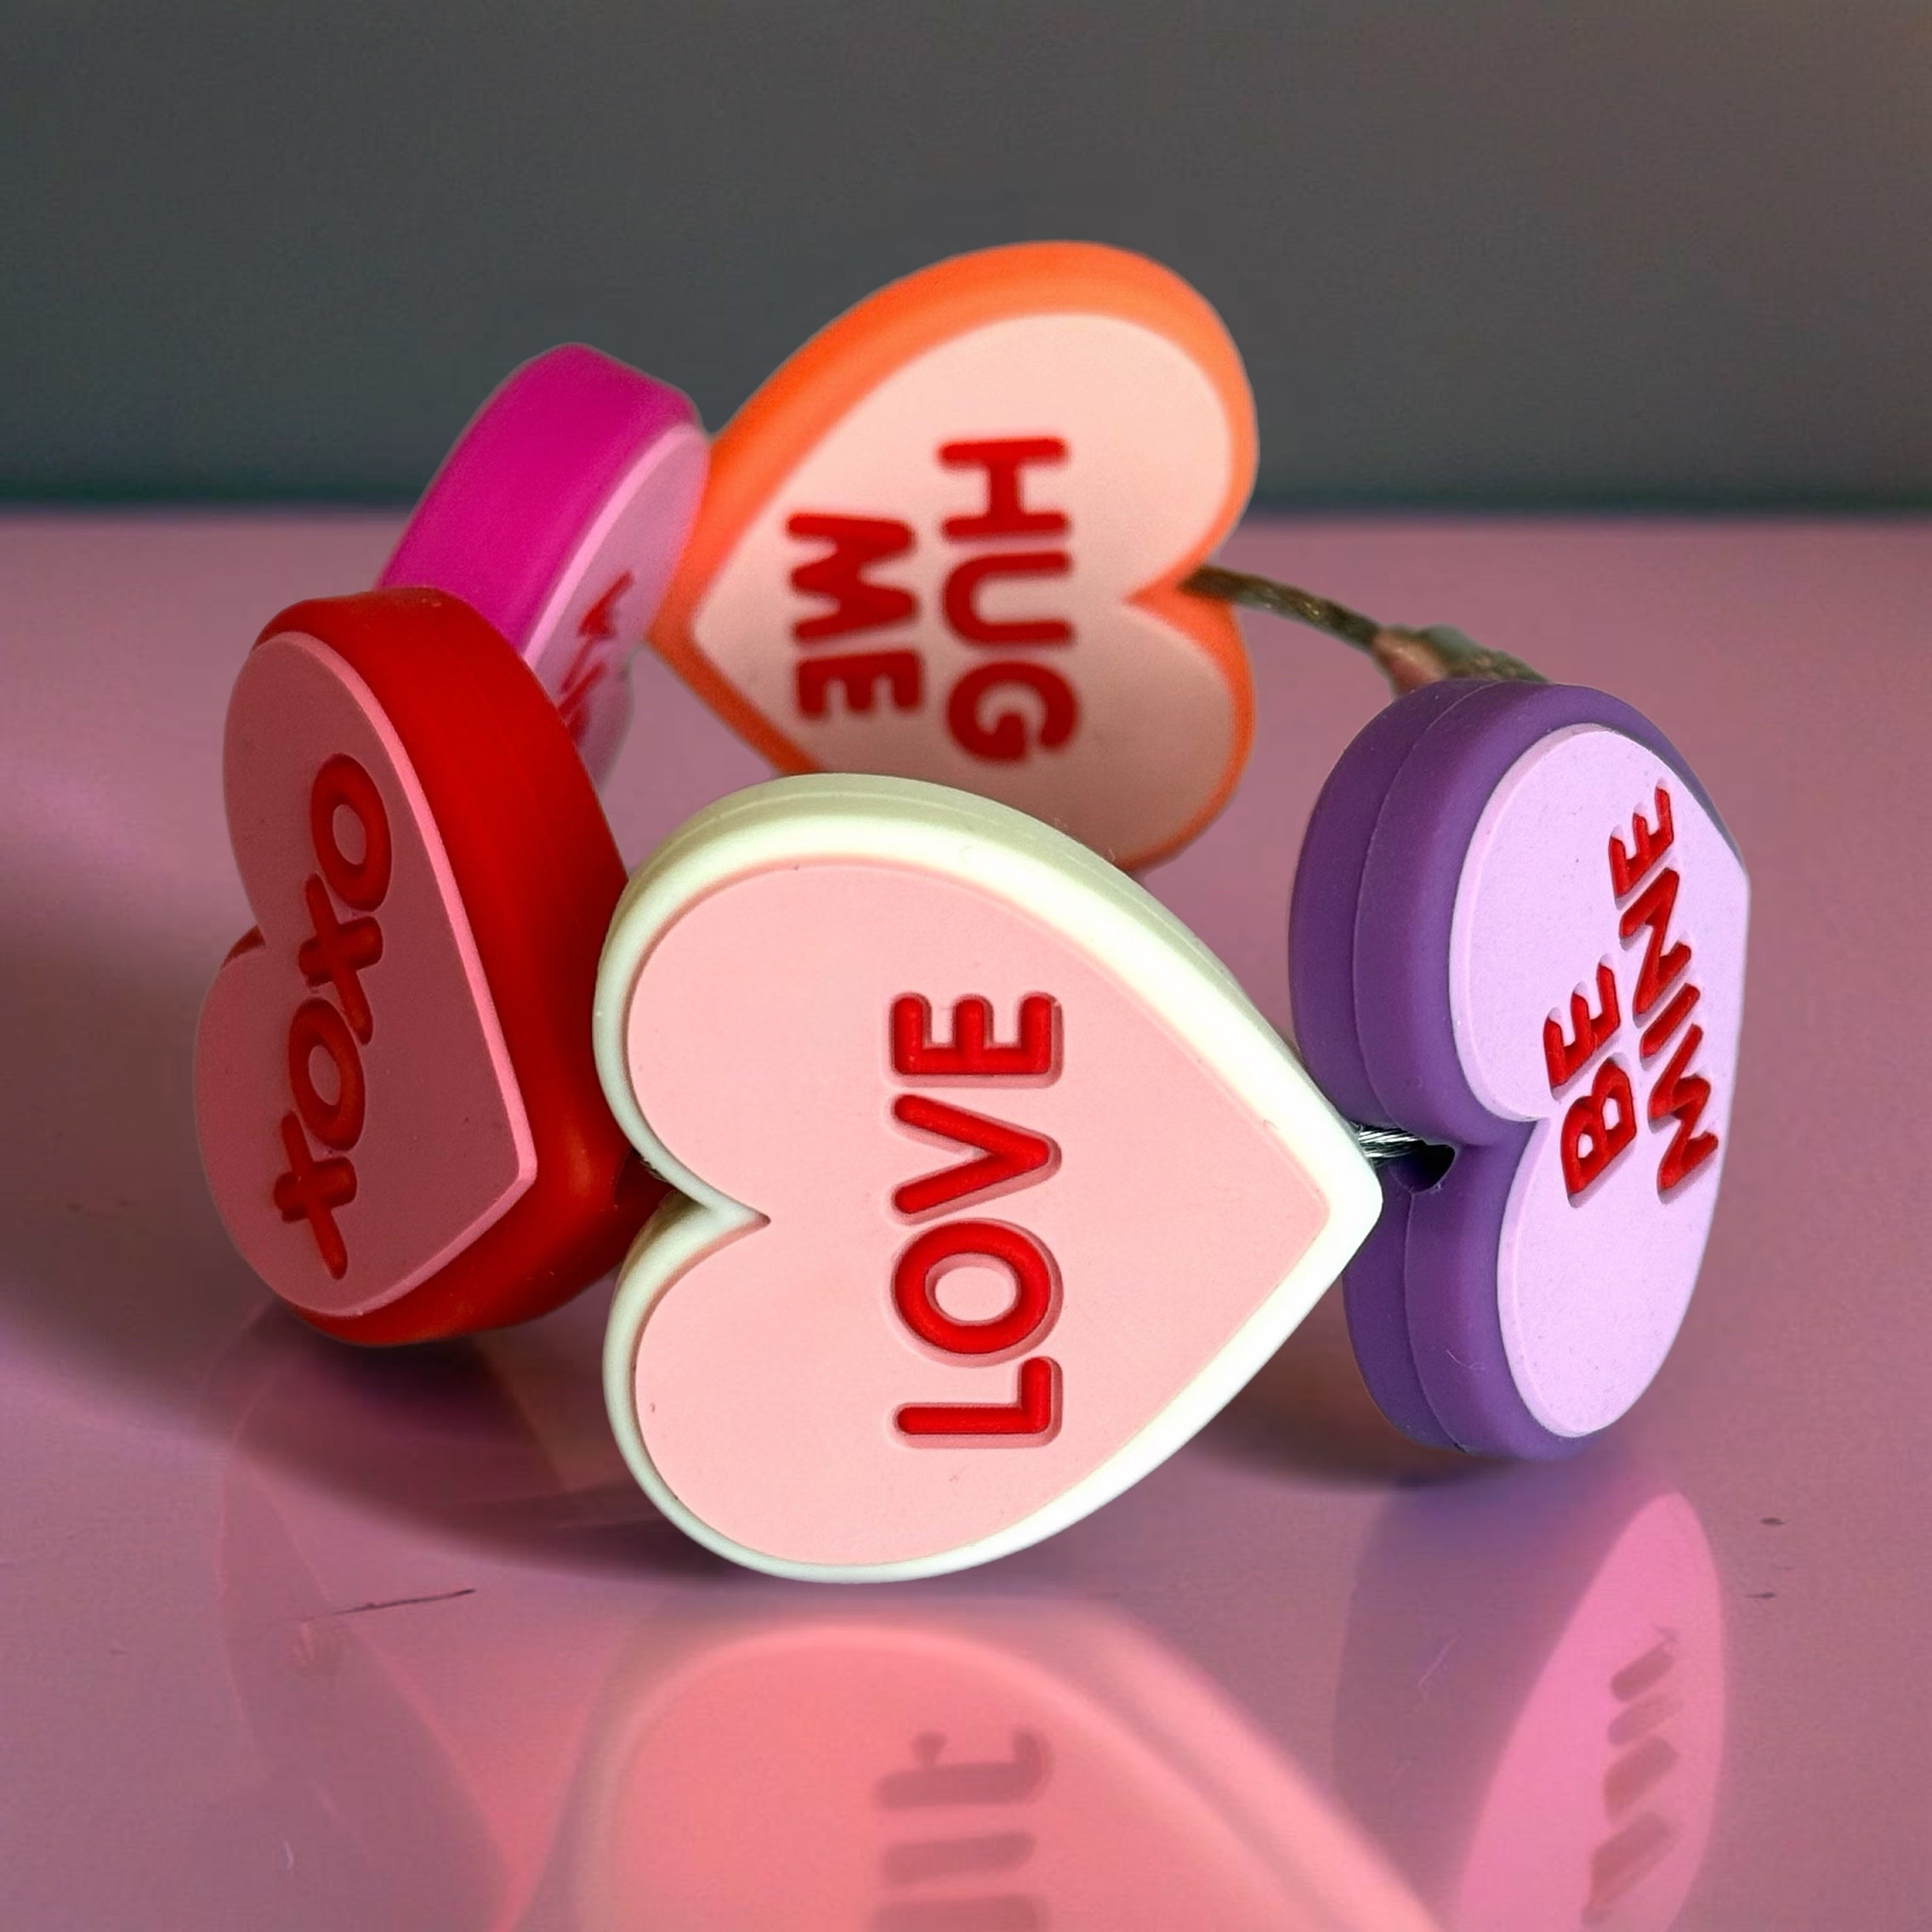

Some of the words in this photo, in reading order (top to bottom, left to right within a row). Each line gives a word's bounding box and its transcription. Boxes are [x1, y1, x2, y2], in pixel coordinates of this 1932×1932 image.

[786, 512, 922, 717] ME
[937, 436, 1078, 764] HUG
[273, 753, 391, 1280] XOXO
[1543, 962, 1637, 1201] BE
[1608, 786, 1719, 1192] MINE
[890, 994, 1058, 1439] LOVE
